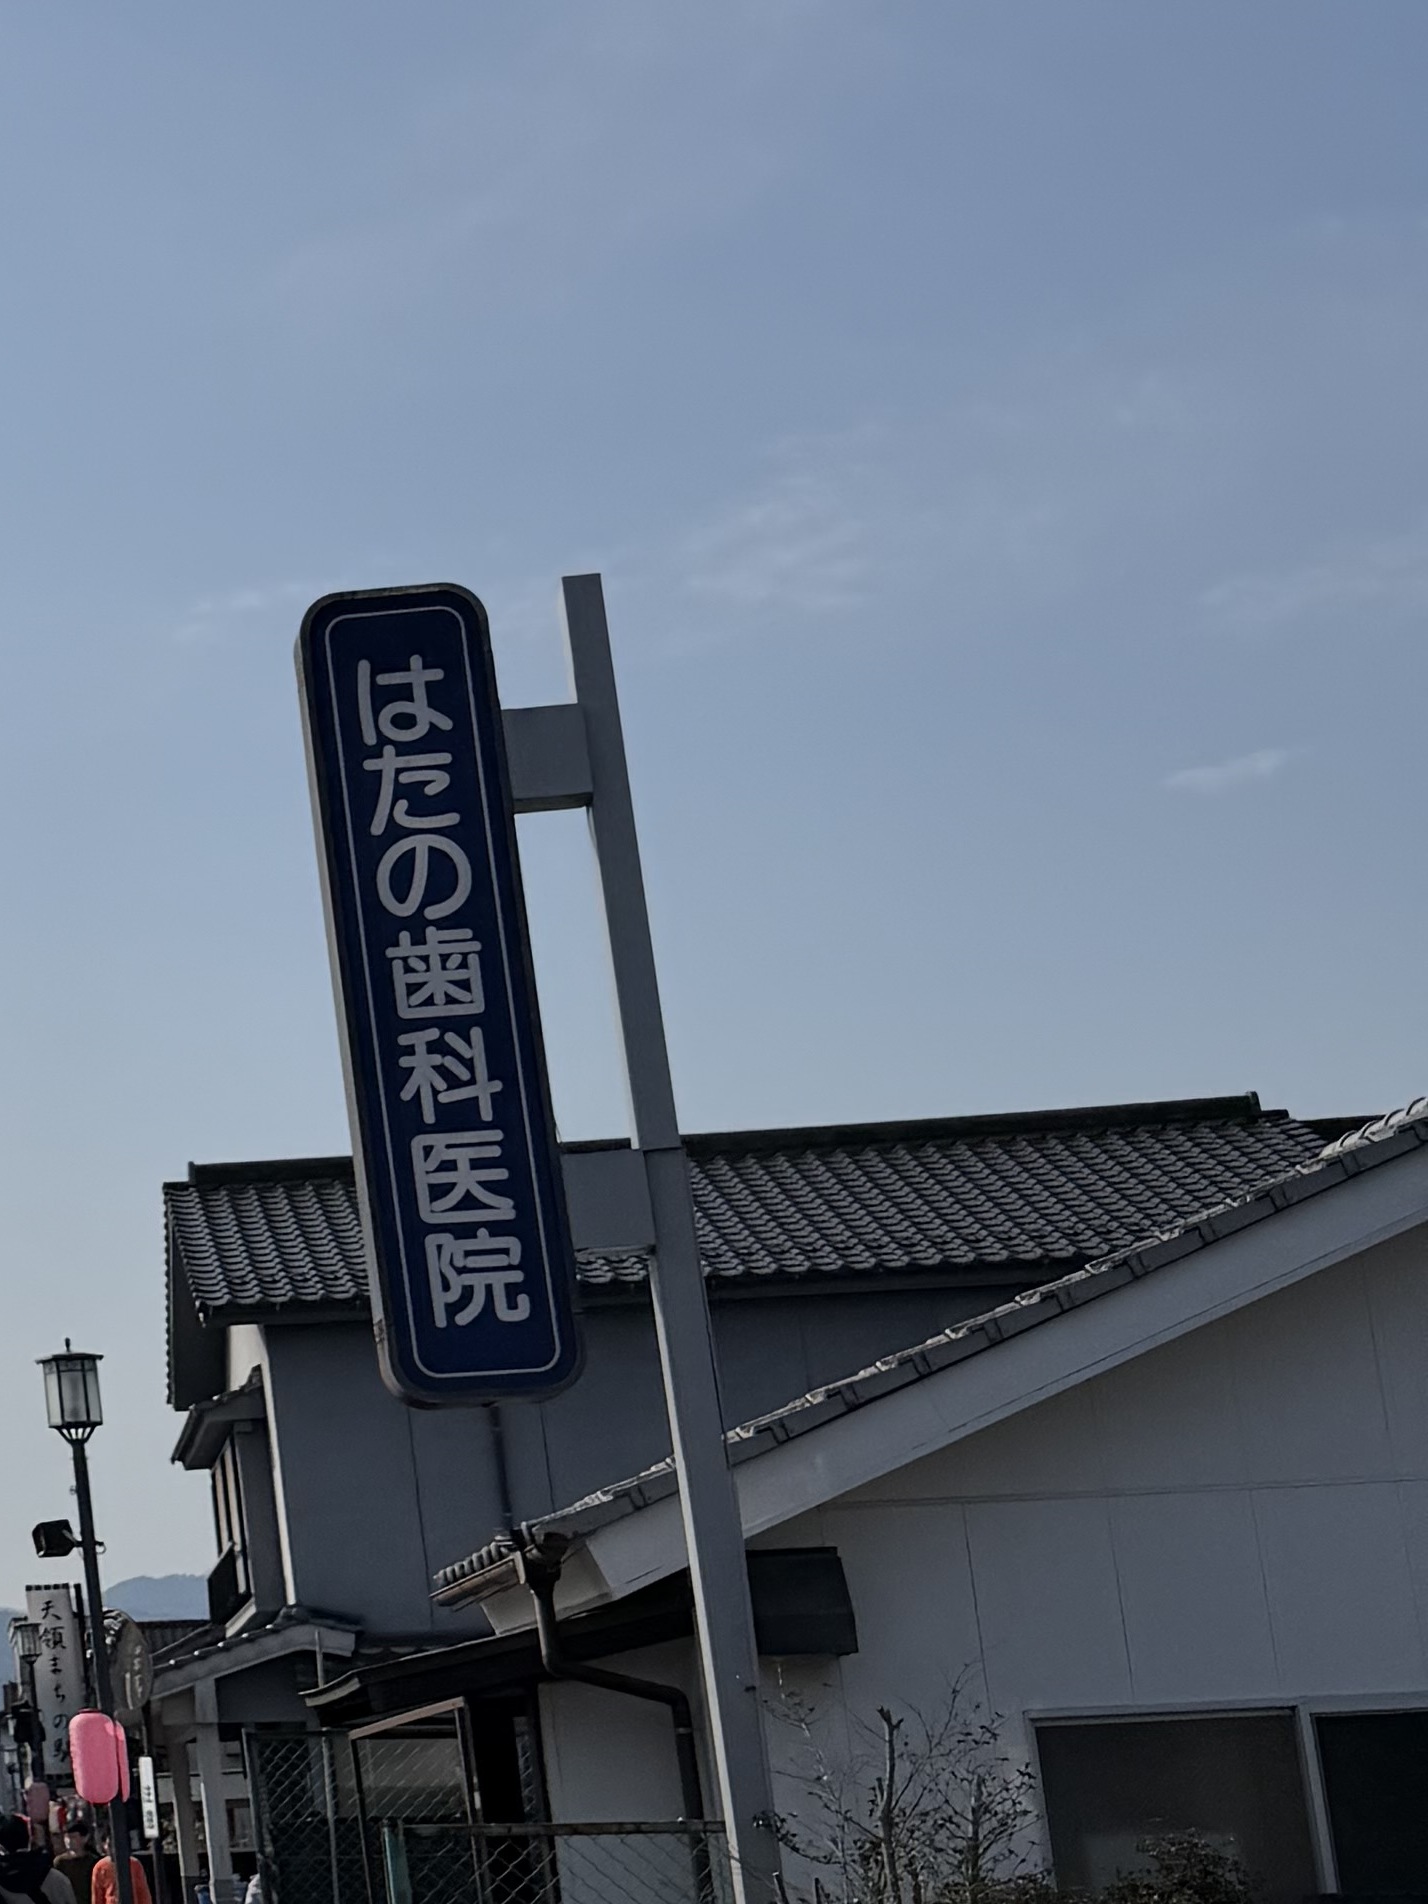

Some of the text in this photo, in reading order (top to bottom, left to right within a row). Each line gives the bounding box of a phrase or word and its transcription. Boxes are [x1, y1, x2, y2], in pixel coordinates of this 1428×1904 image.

[356, 653, 531, 1329] はたの歯科医院
